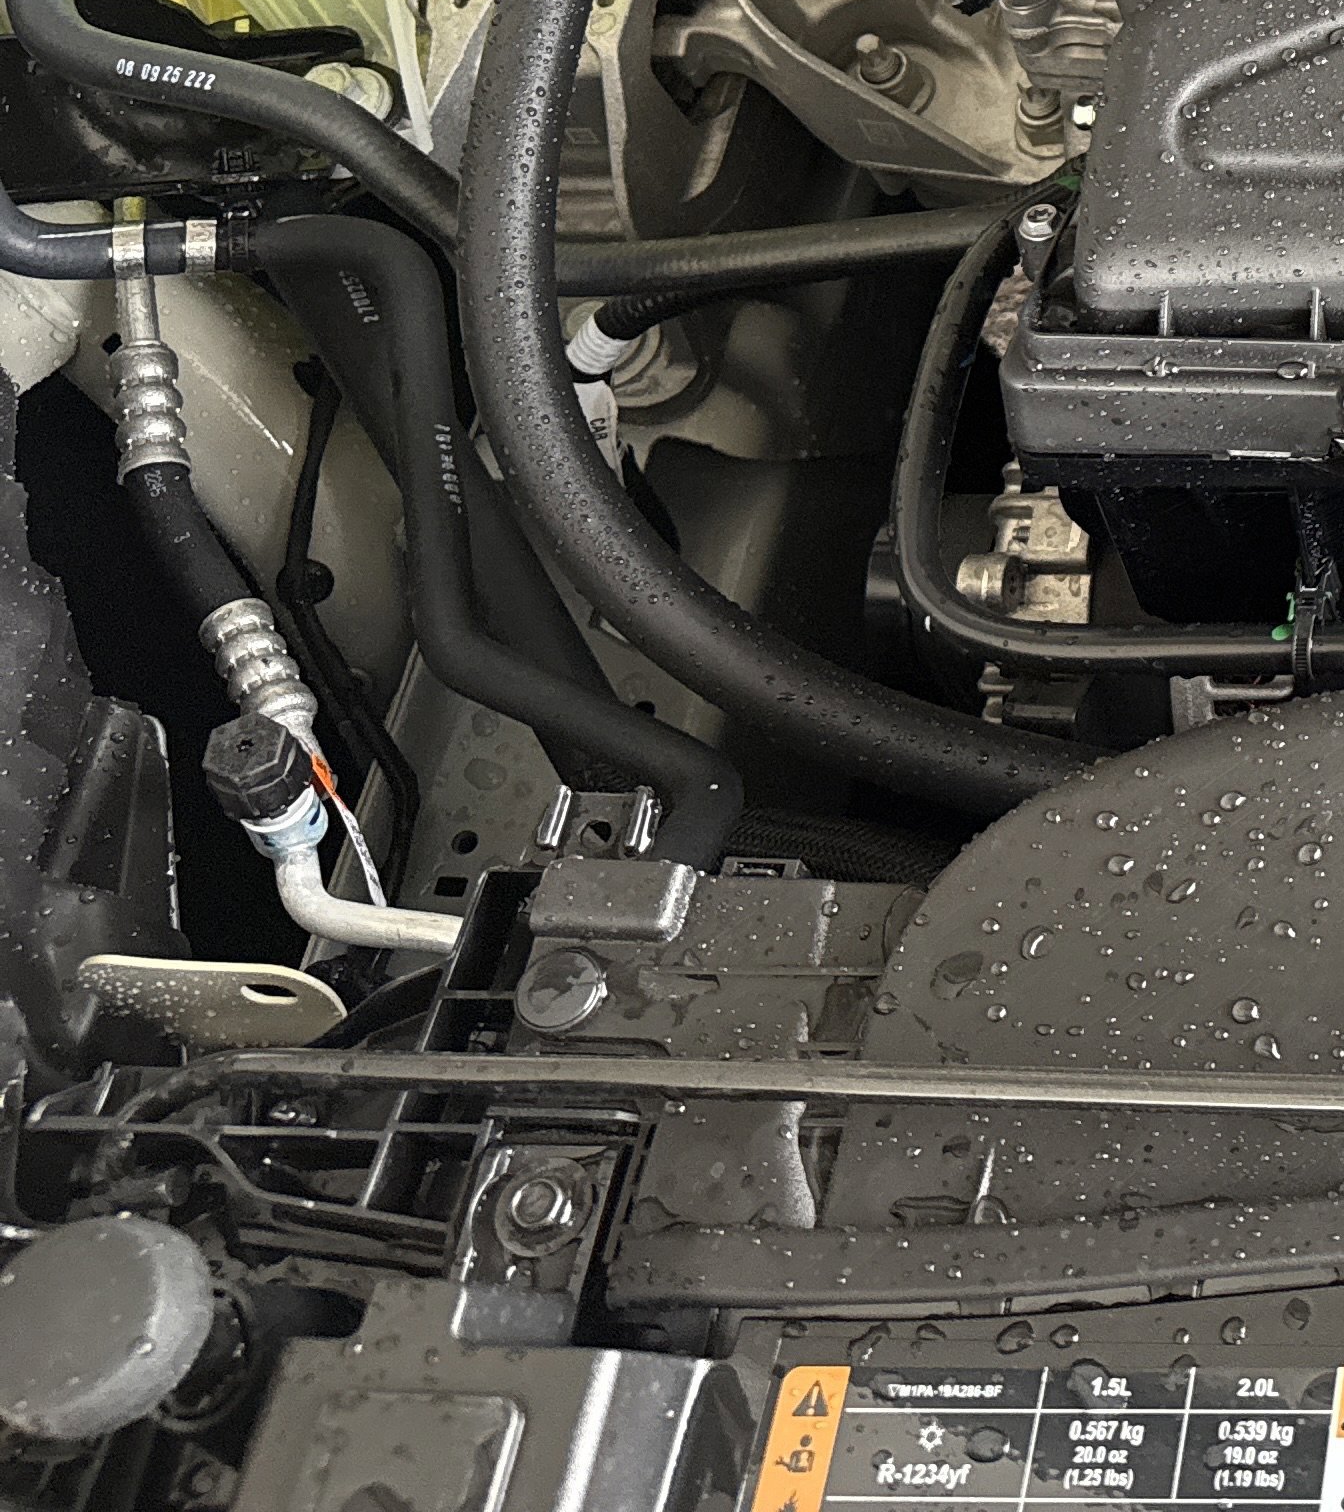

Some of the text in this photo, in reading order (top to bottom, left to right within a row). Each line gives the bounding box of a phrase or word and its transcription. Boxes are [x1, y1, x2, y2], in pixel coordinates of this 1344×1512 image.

[116, 58, 217, 91] 08 09 25 222
[1090, 1377, 1132, 1396] 1.5L
[1236, 1378, 1279, 1397] 2.0L
[1068, 1420, 1145, 1447] 0.567 kg
[1218, 1420, 1294, 1446] 0.539 kg
[1072, 1447, 1129, 1464] 20.0 oz
[1222, 1447, 1278, 1464] 19.0 oz
[877, 1463, 971, 1489] R-1234yf
[1063, 1468, 1135, 1489] (1.25 lbs)
[1214, 1468, 1285, 1490] (1.19 lbs)
